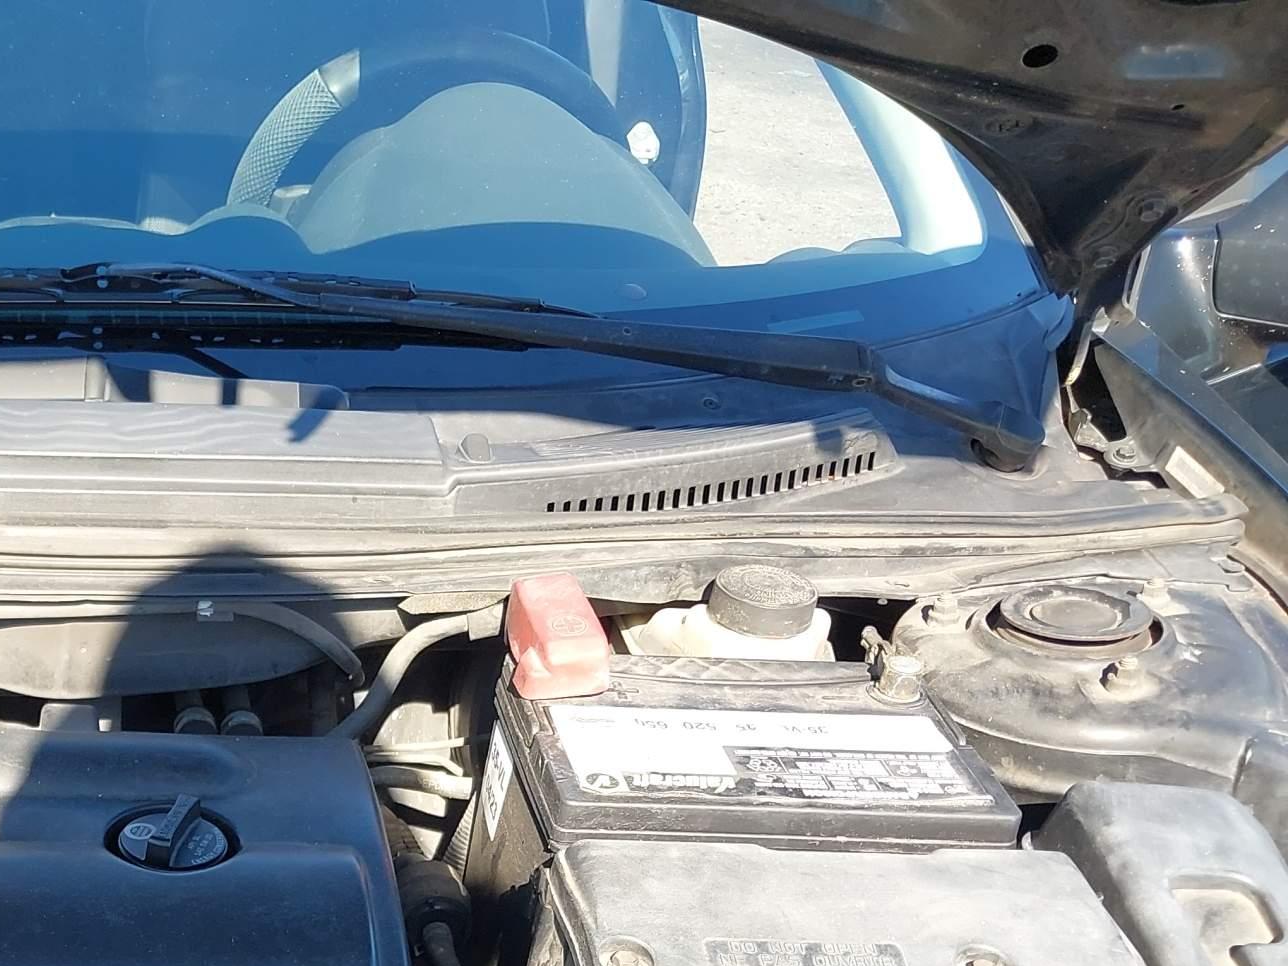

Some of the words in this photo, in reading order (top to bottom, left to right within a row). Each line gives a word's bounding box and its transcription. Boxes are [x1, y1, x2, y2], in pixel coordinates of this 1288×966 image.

[729, 941, 758, 954] DO
[768, 941, 808, 955] NOT
[821, 942, 879, 956] OPEN
